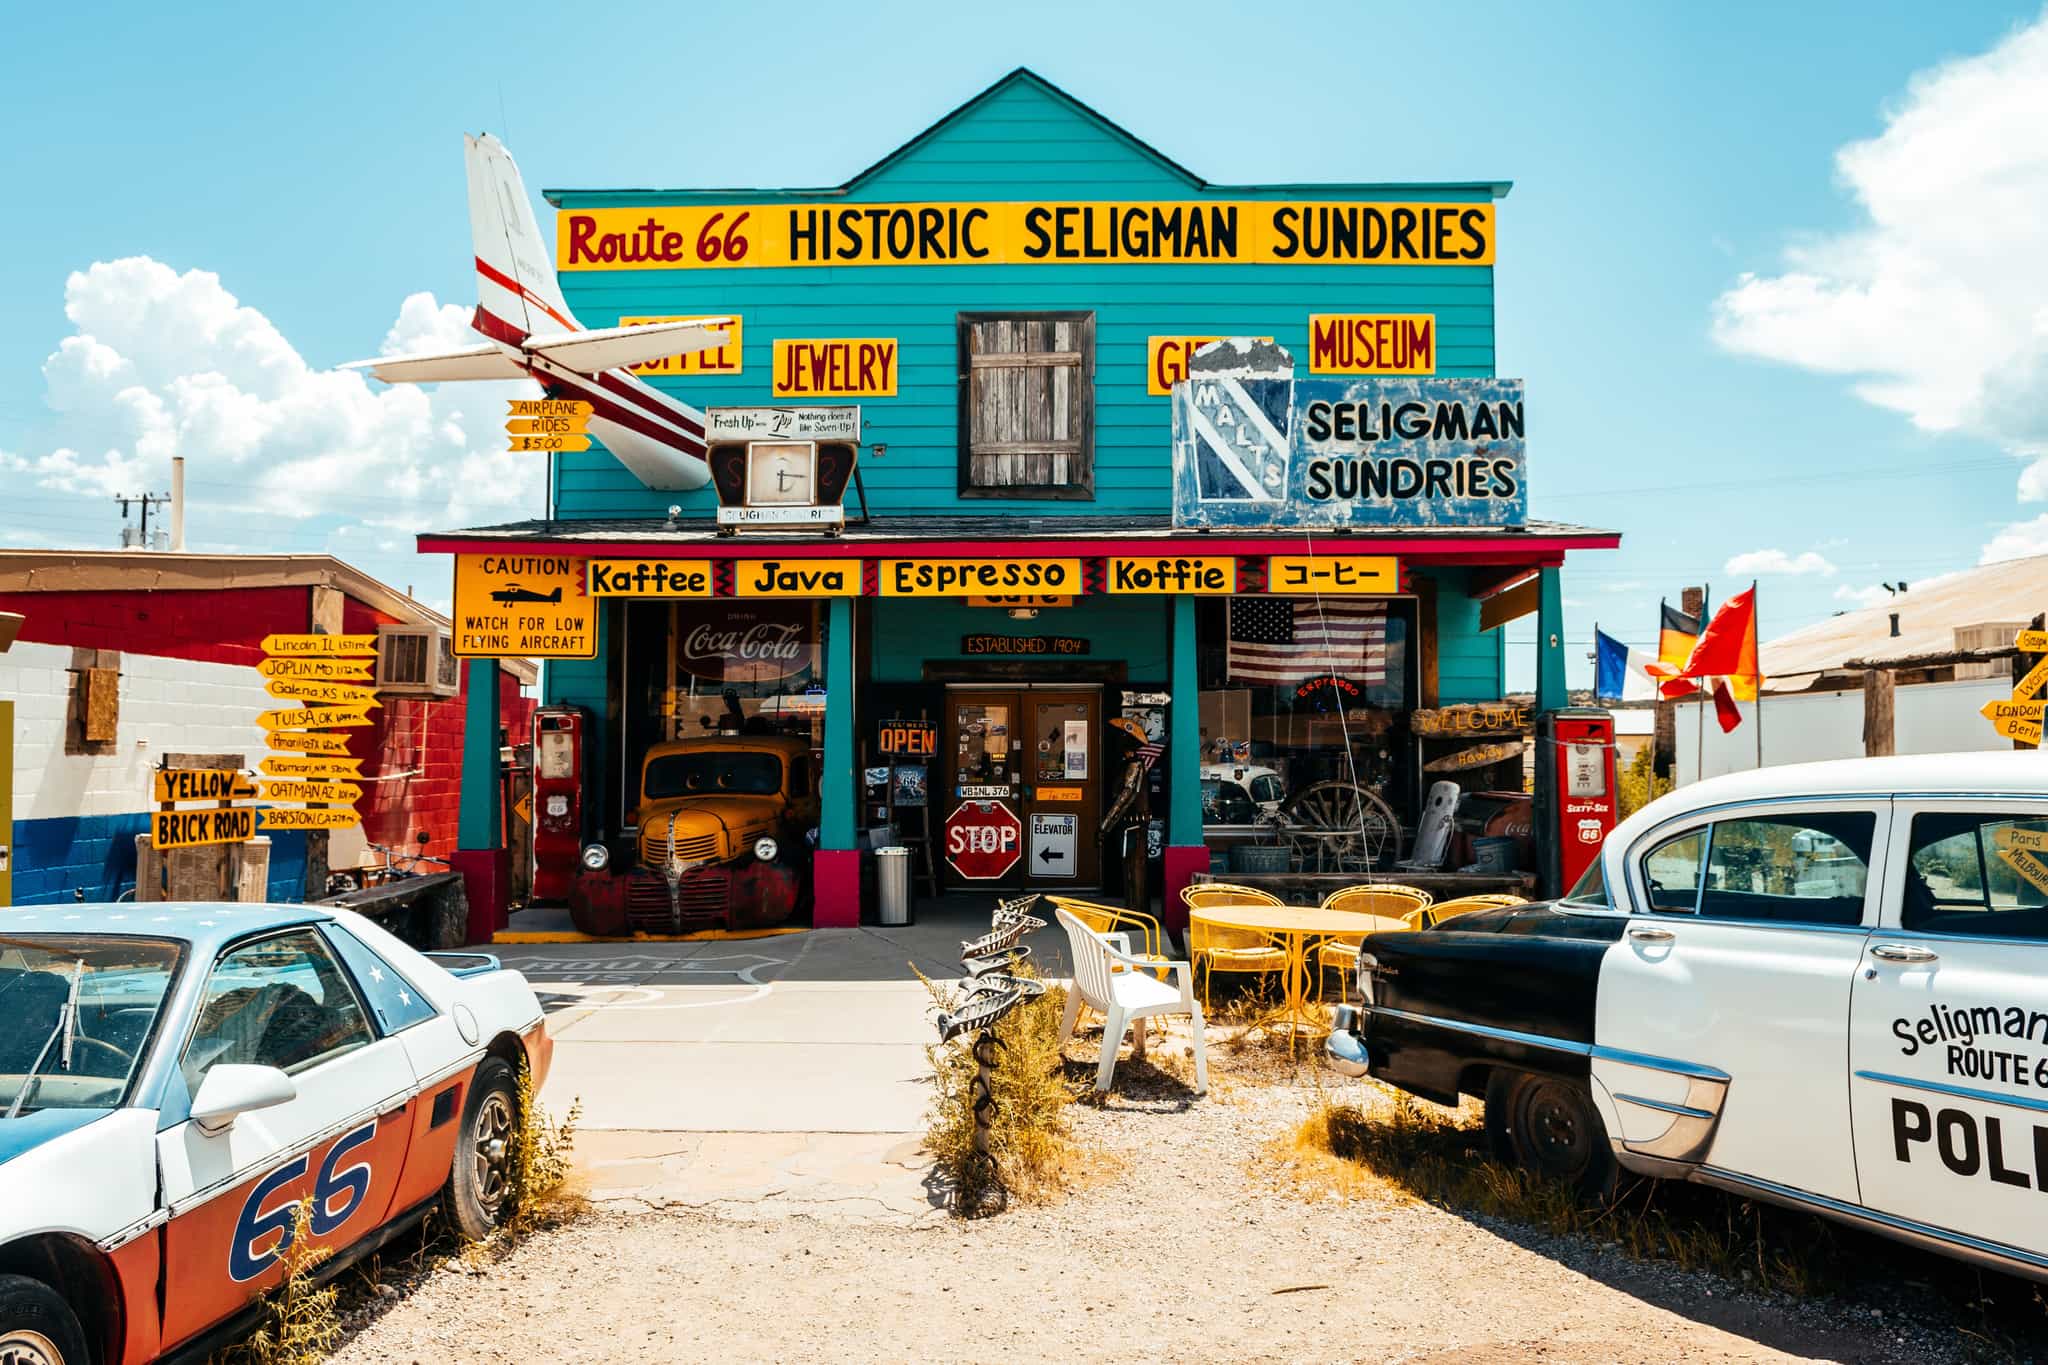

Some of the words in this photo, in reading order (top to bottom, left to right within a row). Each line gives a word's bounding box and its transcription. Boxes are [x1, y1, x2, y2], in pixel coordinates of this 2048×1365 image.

[568, 216, 683, 264] Route
[697, 211, 750, 261] 66
[788, 207, 989, 260] HISTORIC
[1023, 206, 1238, 259] SELIGMAN
[1271, 207, 1487, 259] SUNDRIES
[1314, 319, 1431, 370] MUSEUM
[777, 342, 894, 393] JEWELRY
[519, 401, 579, 415] AIRPLANE
[799, 411, 826, 423] Nothing
[827, 411, 844, 420] does
[845, 411, 852, 420] it
[532, 419, 570, 432] RIDES
[1307, 401, 1524, 441] SELIGMAN
[1195, 384, 1281, 487] MALTS
[1308, 458, 1516, 500] SUNDRIES
[483, 558, 570, 576] CAUTION
[592, 564, 705, 593] Kaffee
[754, 562, 844, 592] Java
[895, 562, 1066, 593] Espresso
[1115, 560, 1225, 590] Koffie
[1285, 561, 1380, 586] コーヒー
[466, 617, 508, 631] WATCH
[519, 617, 545, 631] FOR
[556, 617, 584, 631] LOW
[322, 638, 335, 651] IL
[463, 635, 509, 649] FLYING
[521, 636, 584, 650] AIRCRAFT
[968, 638, 1046, 653] ESTABLISHED
[1053, 638, 1082, 653] 1904
[322, 687, 337, 699] KS
[319, 712, 332, 723] OK
[1423, 708, 1529, 733] WELCOME
[1996, 704, 2041, 718] LONDON
[880, 728, 936, 753] OPEN
[164, 773, 235, 798] YELLOW
[322, 786, 335, 799] AZ
[992, 786, 1009, 796] 376
[159, 813, 208, 845] BRICK
[214, 811, 250, 840] ROAD
[317, 813, 331, 824] CA
[1034, 823, 1073, 835] ELEVATOR
[949, 825, 1017, 853] STOP
[1581, 830, 1598, 840] 66
[2011, 830, 2041, 847] Paris
[520, 960, 706, 970] ROUTE
[1892, 1003, 2048, 1056] Seligman
[1947, 1045, 2029, 1086] ROUTE
[228, 1118, 380, 1282] 66
